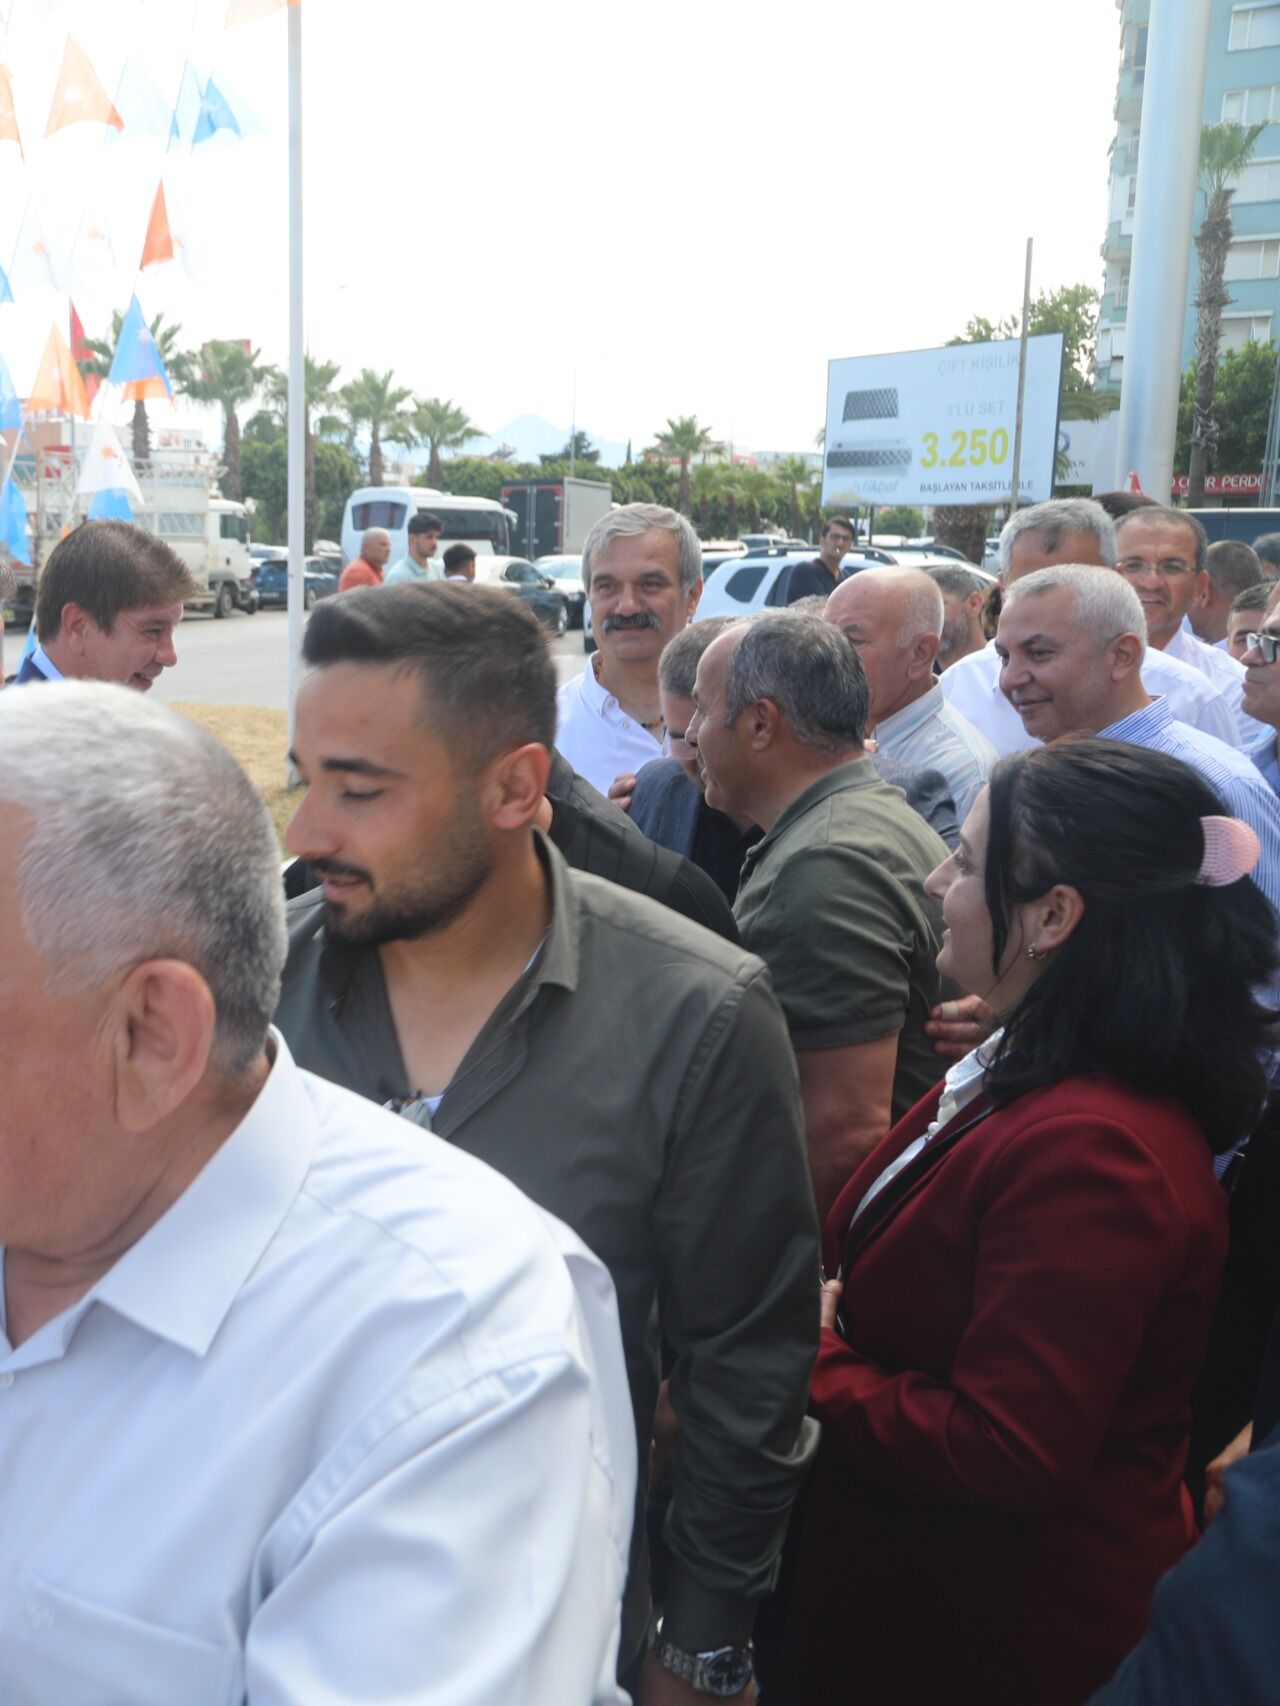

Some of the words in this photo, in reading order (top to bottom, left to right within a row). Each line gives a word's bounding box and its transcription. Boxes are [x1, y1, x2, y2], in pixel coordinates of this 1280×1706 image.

[978, 399, 1005, 415] SET
[920, 427, 1009, 469] 3.250
[919, 481, 967, 496] BAŞLAYAN
